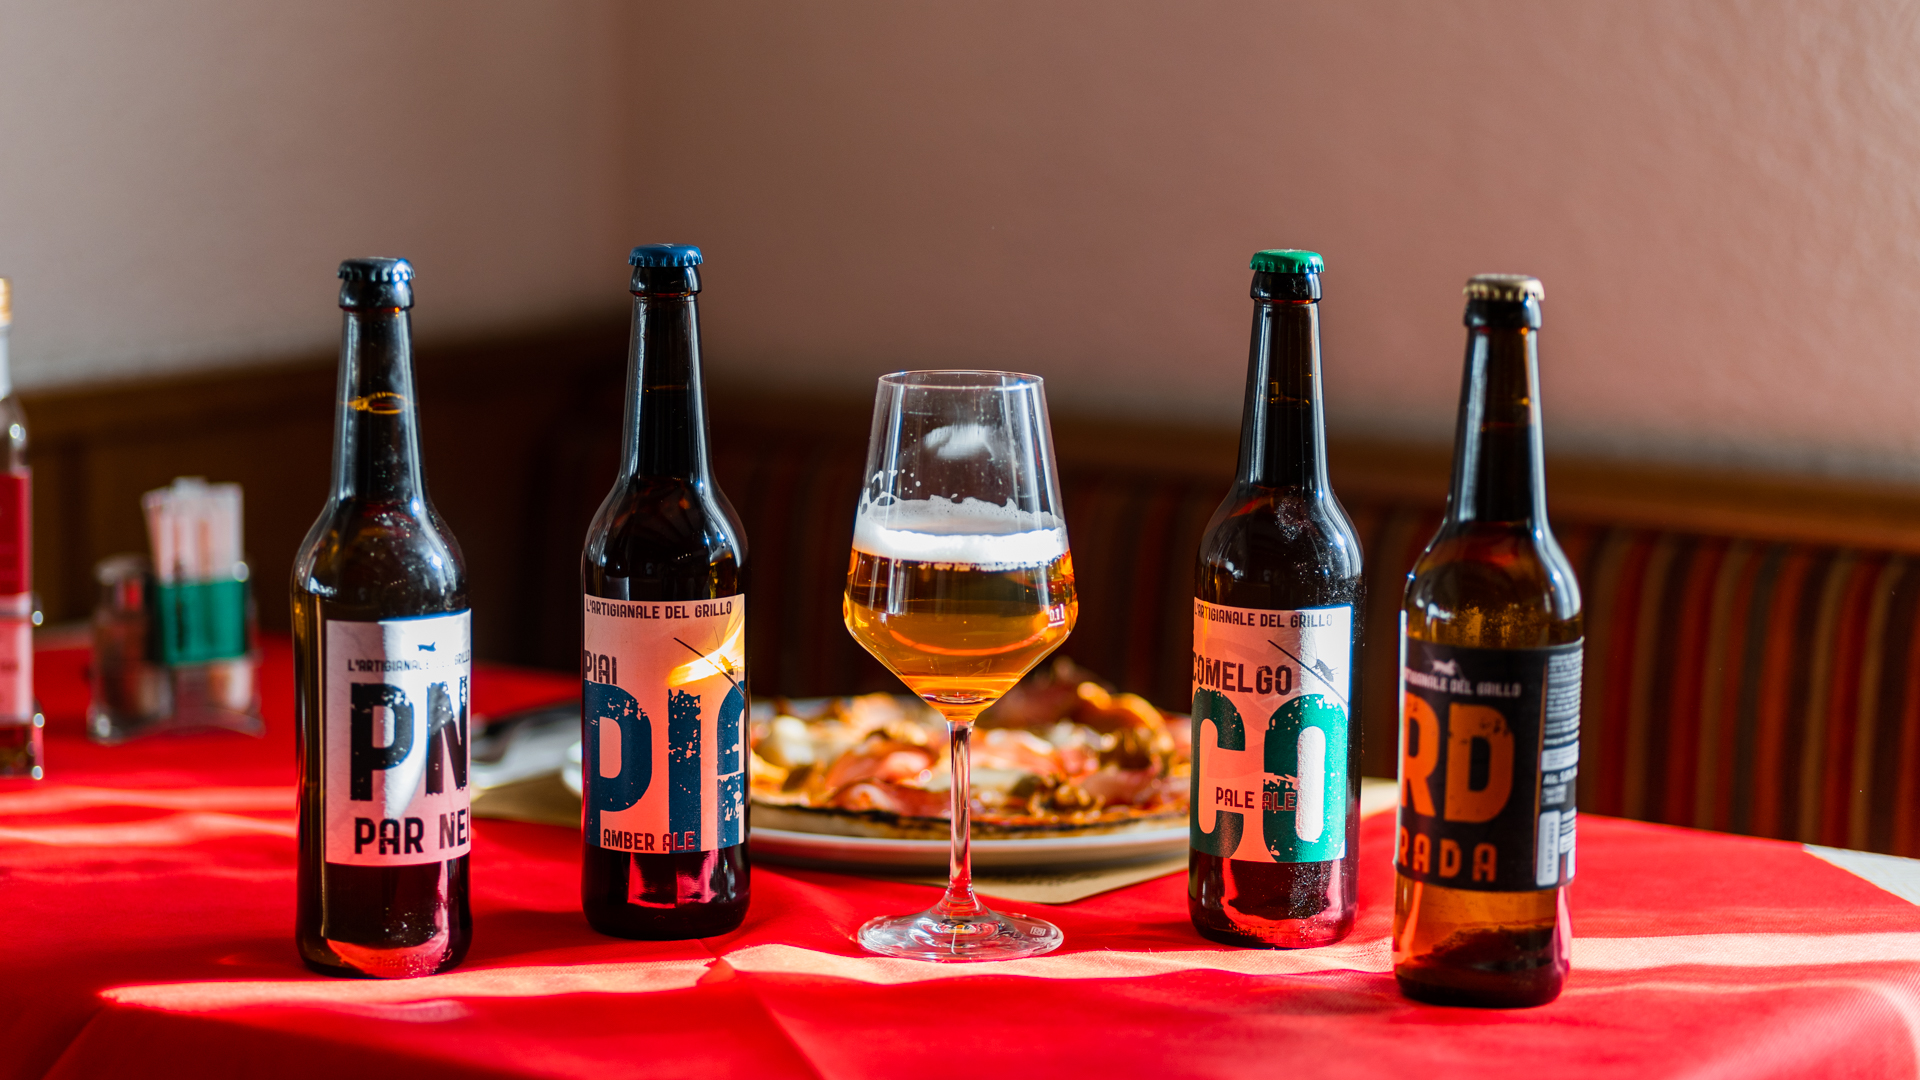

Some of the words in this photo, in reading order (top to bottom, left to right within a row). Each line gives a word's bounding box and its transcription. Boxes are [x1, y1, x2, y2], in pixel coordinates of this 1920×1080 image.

[586, 598, 660, 620] L'ARTIGIANALE
[665, 605, 690, 619] DEL
[694, 601, 732, 618] GRILLO
[1194, 601, 1256, 627] L'ARTIGIANALE
[1260, 613, 1285, 628] DEL
[1290, 613, 1333, 628] GRILLO
[347, 659, 428, 673] L'ARTIGIANA
[584, 649, 617, 685] PIAI
[1450, 678, 1473, 696] DEL
[1476, 682, 1522, 698] GRILLO
[1402, 691, 1515, 824] RD
[1190, 686, 1349, 864] CO
[1215, 786, 1255, 810] PALE
[1262, 791, 1297, 812] ALE
[354, 816, 424, 855] PAR
[438, 805, 470, 850] NE
[603, 828, 655, 852] AMBER
[662, 831, 696, 852] ALE
[1399, 825, 1498, 883] RADA
